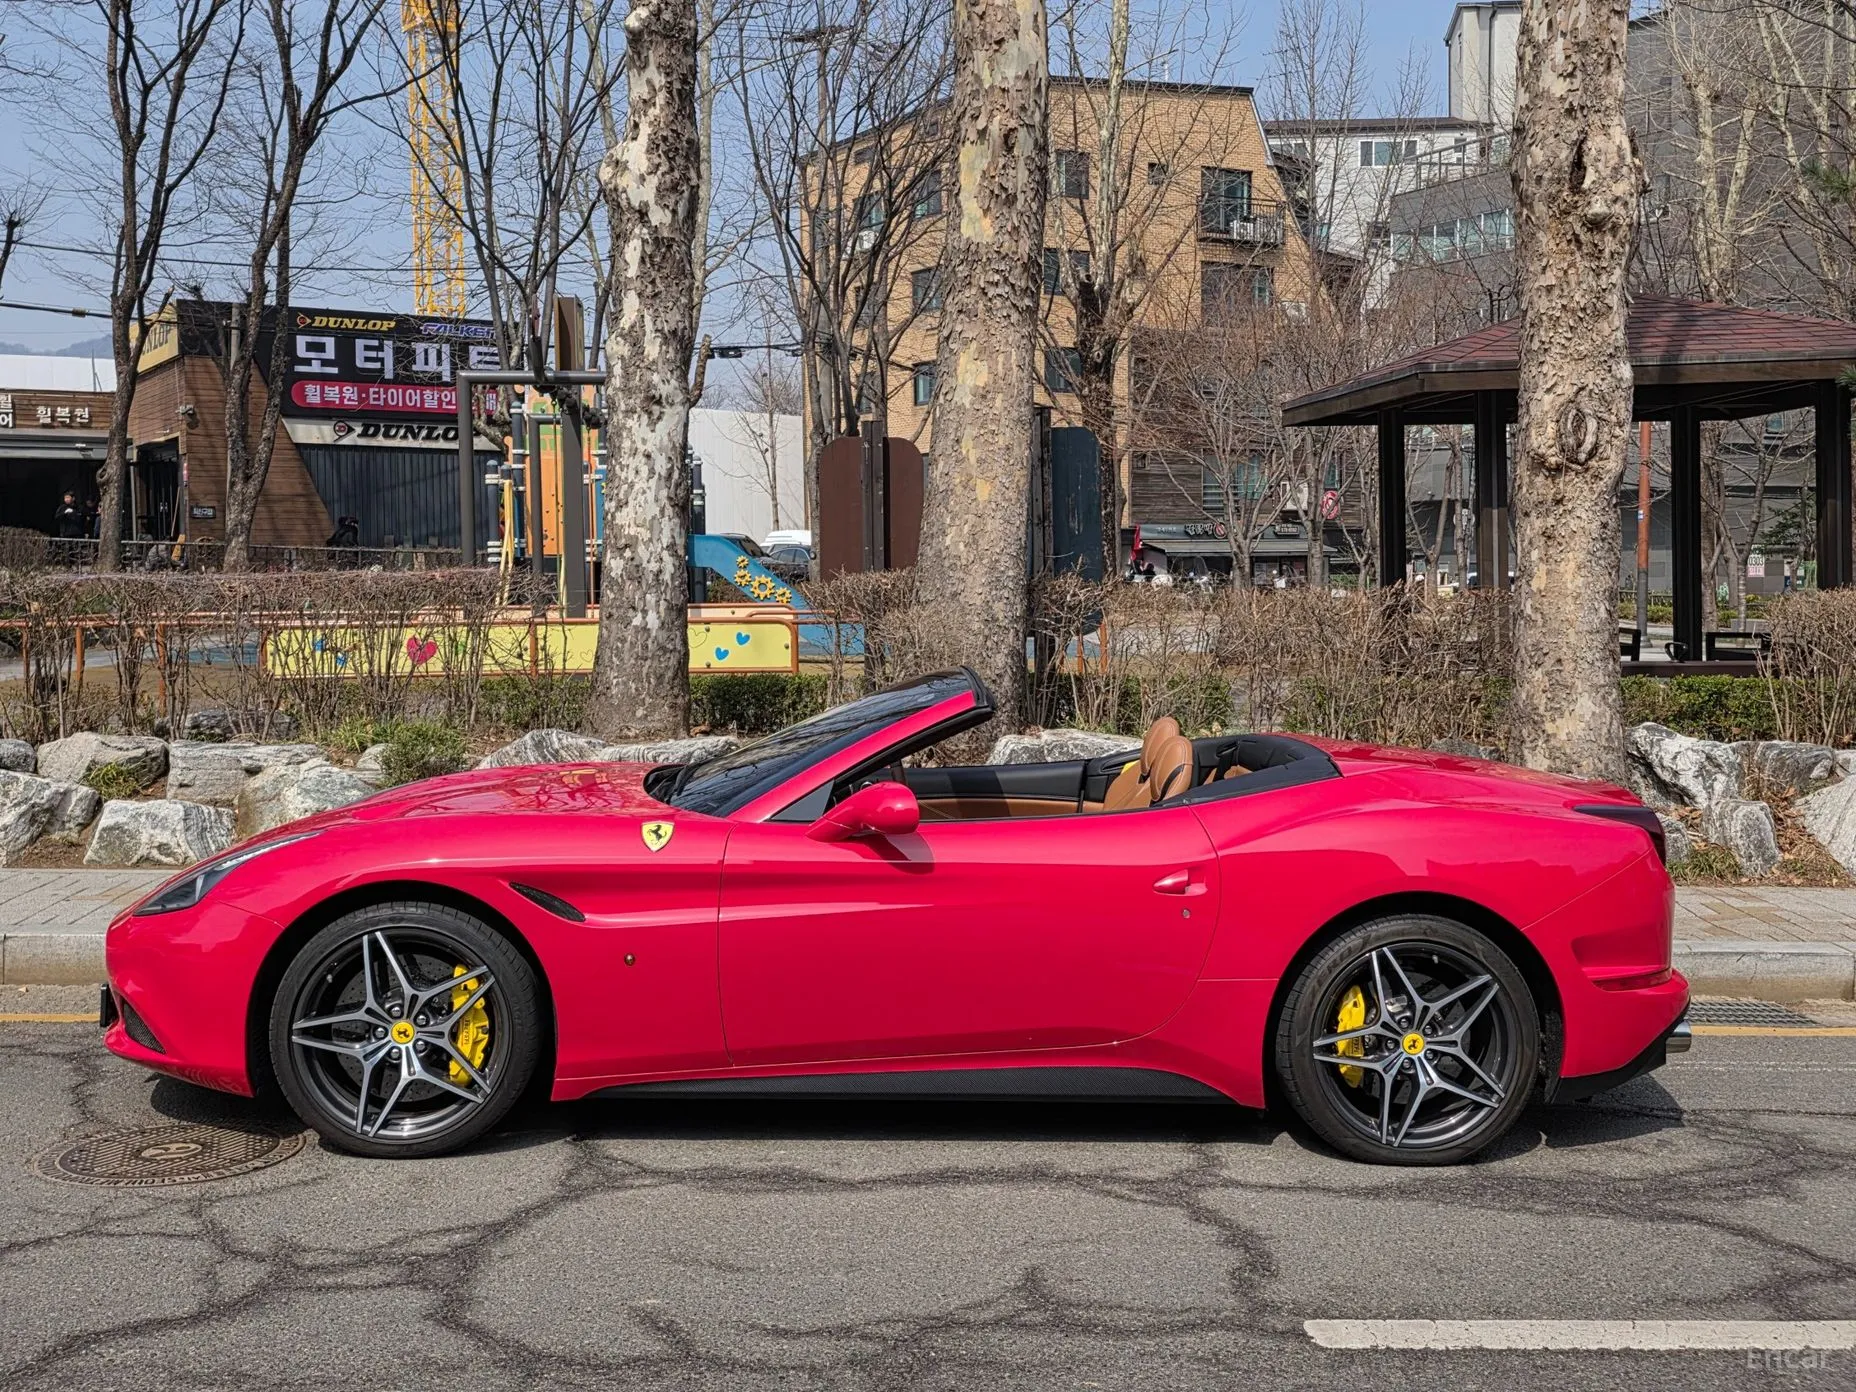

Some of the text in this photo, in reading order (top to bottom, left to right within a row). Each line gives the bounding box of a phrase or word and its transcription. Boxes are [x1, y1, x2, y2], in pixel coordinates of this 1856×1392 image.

[312, 316, 396, 331] DUNLOP
[36, 405, 89, 424] 휠복원
[357, 423, 483, 441] DUNLO
